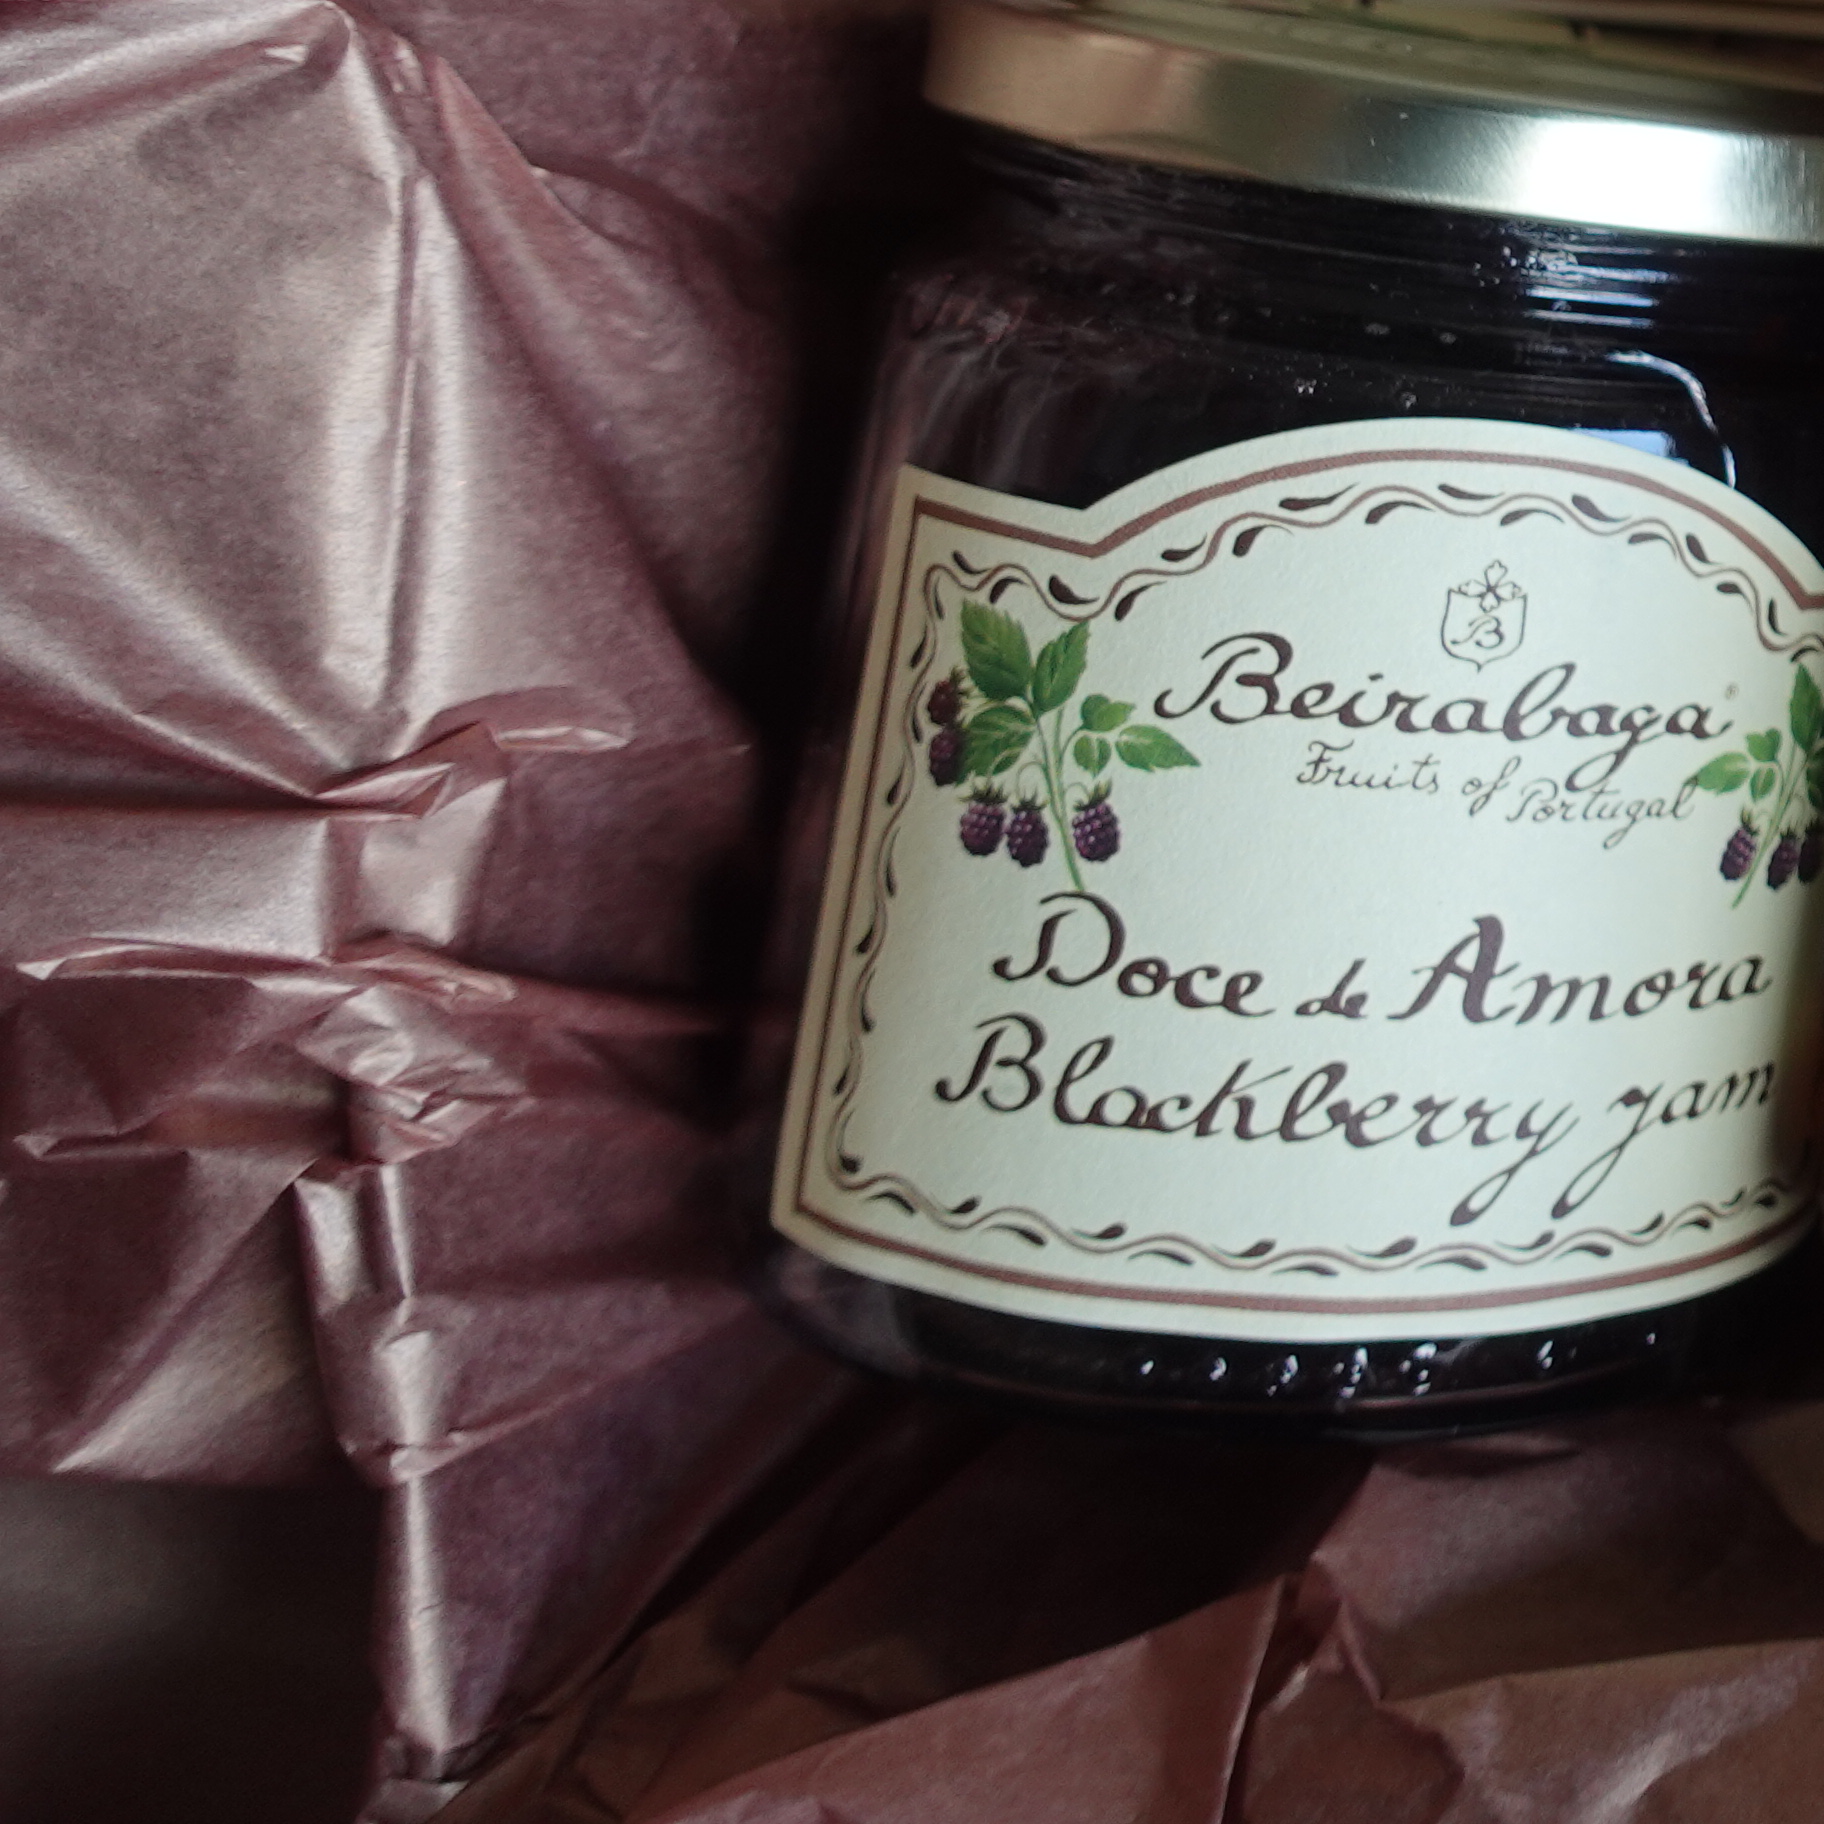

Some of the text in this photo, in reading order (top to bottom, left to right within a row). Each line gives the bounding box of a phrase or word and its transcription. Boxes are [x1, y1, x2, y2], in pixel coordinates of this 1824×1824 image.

[1294, 740, 1697, 851] Fruits of Portugal
[992, 890, 1278, 1018] Doce
[1294, 958, 1369, 1020] de
[1388, 913, 1774, 1027] Amora
[934, 1011, 1580, 1226] Blackberry
